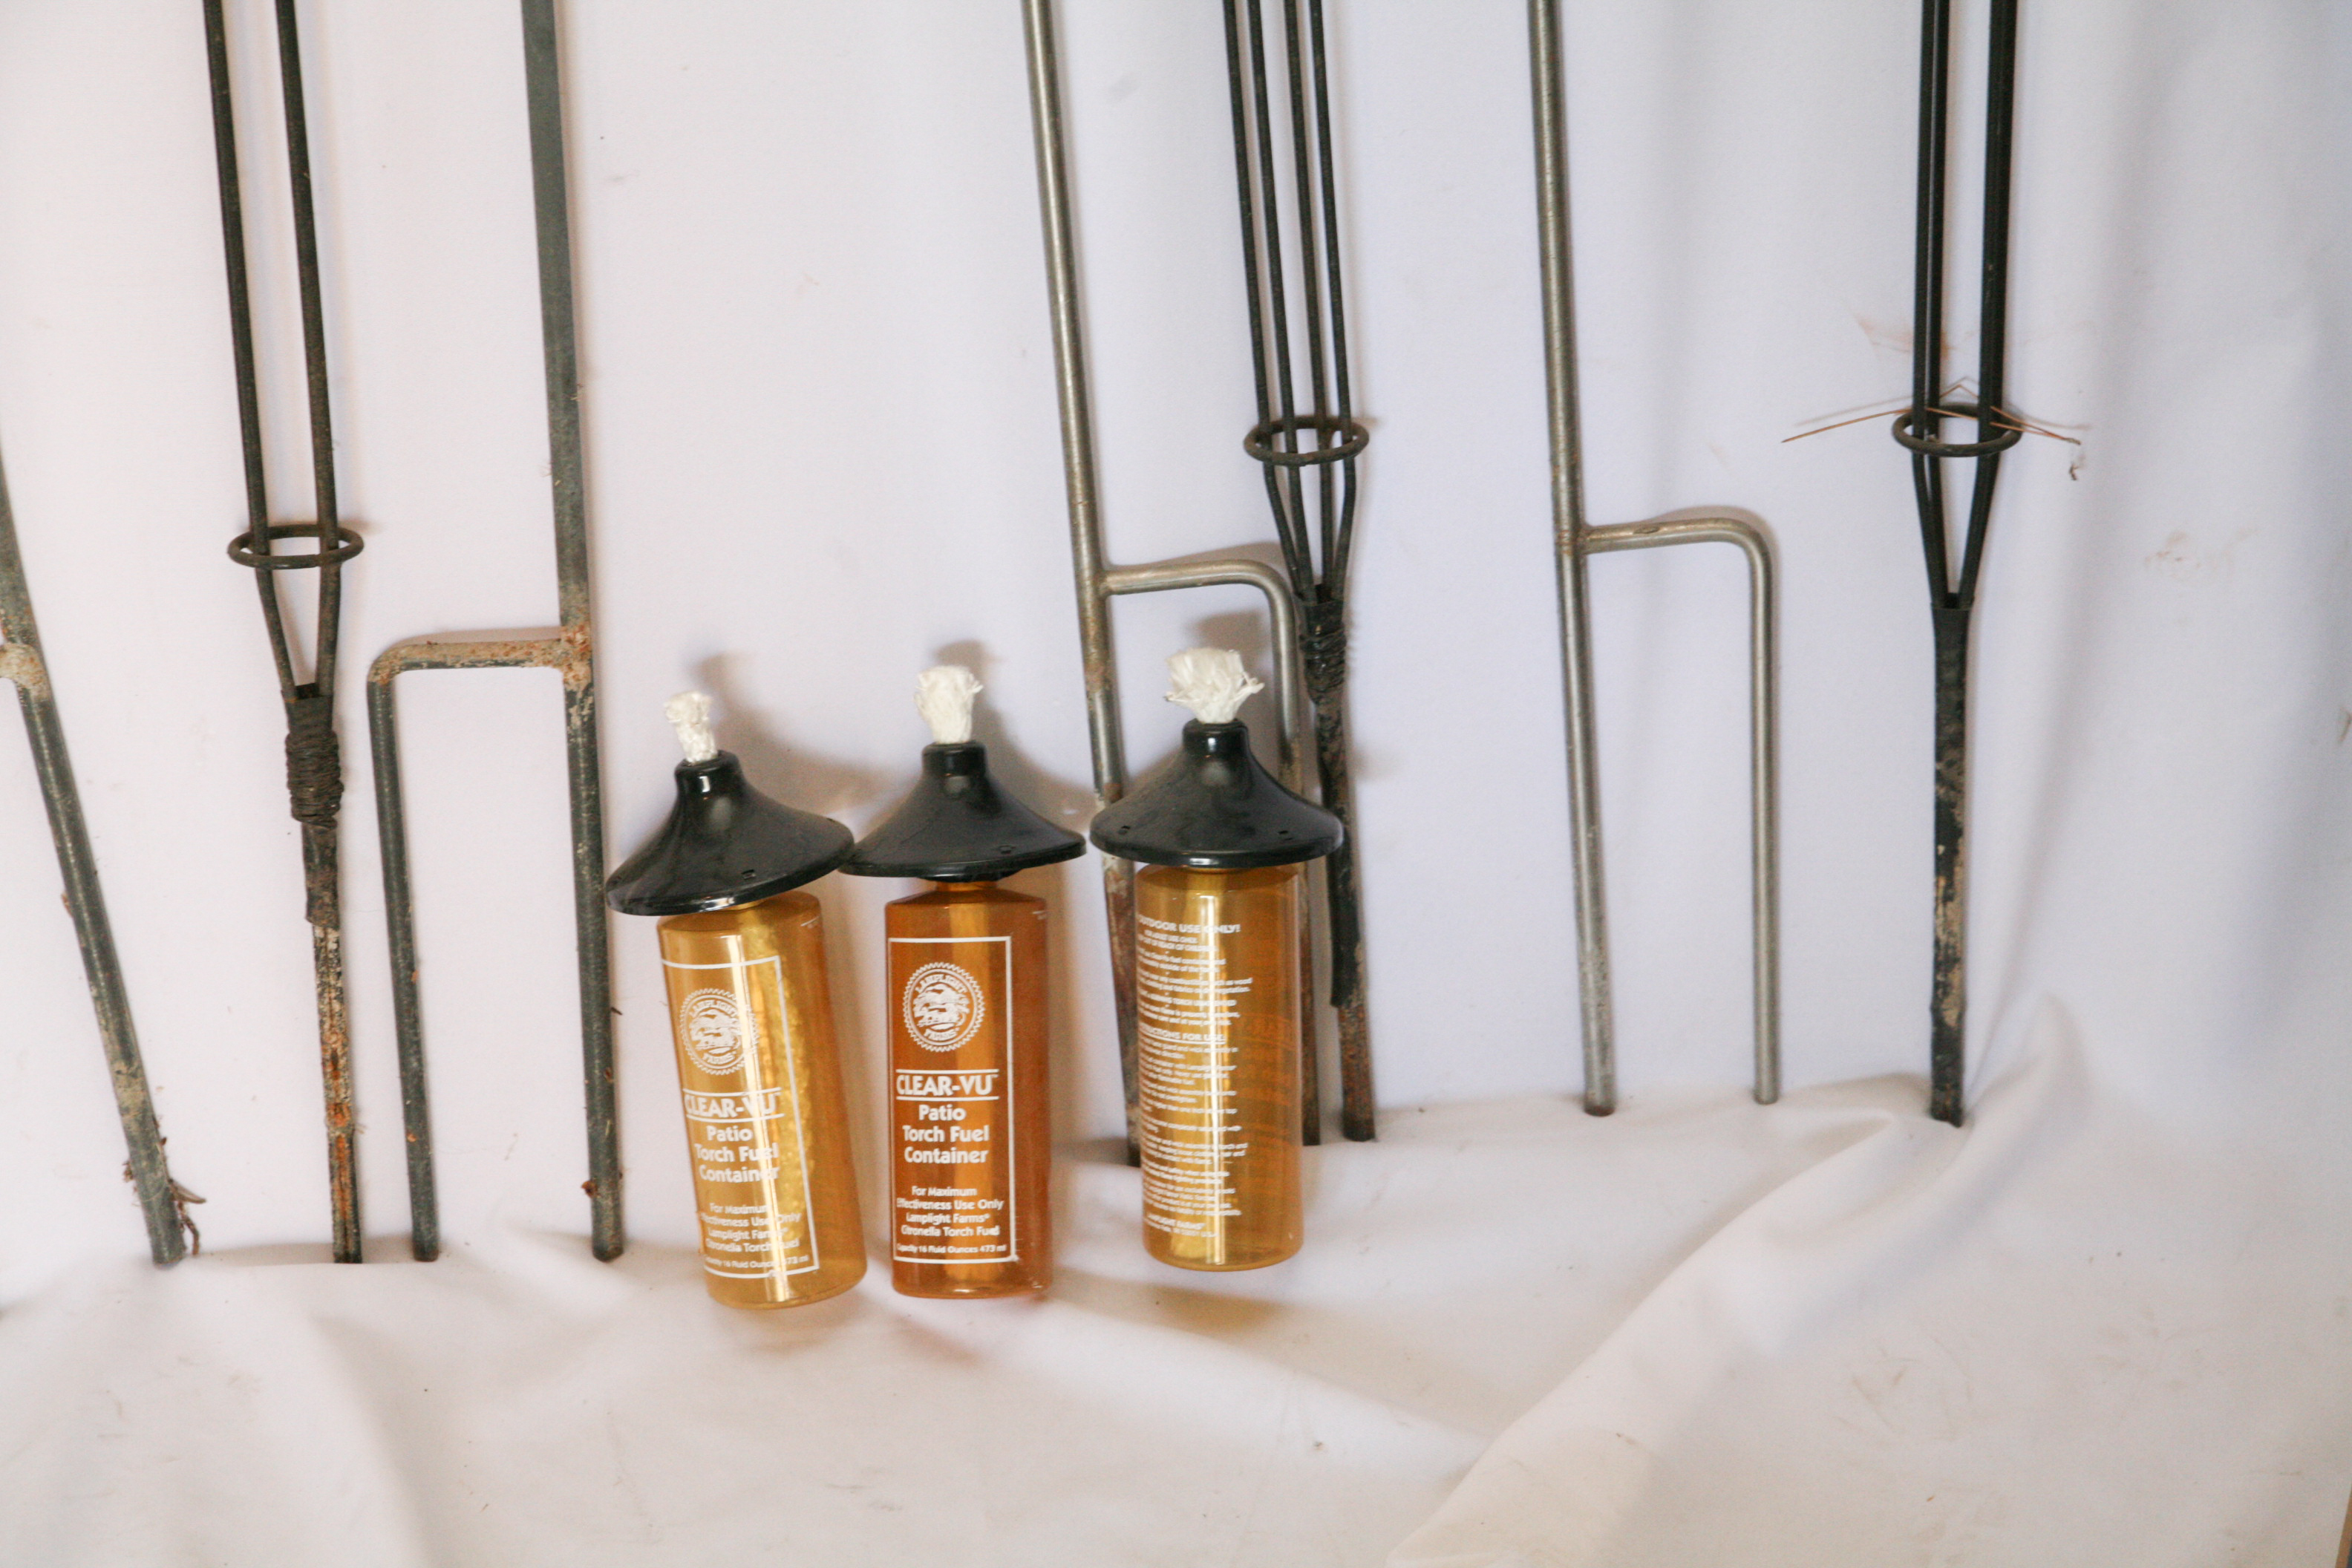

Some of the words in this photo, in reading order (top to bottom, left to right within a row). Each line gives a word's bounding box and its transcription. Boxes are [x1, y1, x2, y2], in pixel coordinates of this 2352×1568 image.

[1178, 924, 1201, 933] USE
[915, 974, 967, 993] LAMPLIGHT
[918, 1104, 967, 1121] Patio
[707, 1125, 753, 1142] Patio
[902, 1125, 944, 1142] Torch
[950, 1125, 990, 1142] Fuel
[694, 1143, 735, 1162] Torch
[739, 1143, 779, 1162] Fuel
[904, 1147, 990, 1164] Container
[699, 1165, 780, 1183] Container
[912, 1186, 927, 1197] For
[928, 1187, 978, 1197] Maximum
[709, 1203, 723, 1213] For
[954, 1200, 975, 1209] Use
[977, 1198, 1004, 1210] Only
[906, 1212, 952, 1225] Lamplight
[943, 1226, 975, 1237] Torch
[976, 1225, 1000, 1236] Fuel
[979, 1244, 996, 1252] 473
